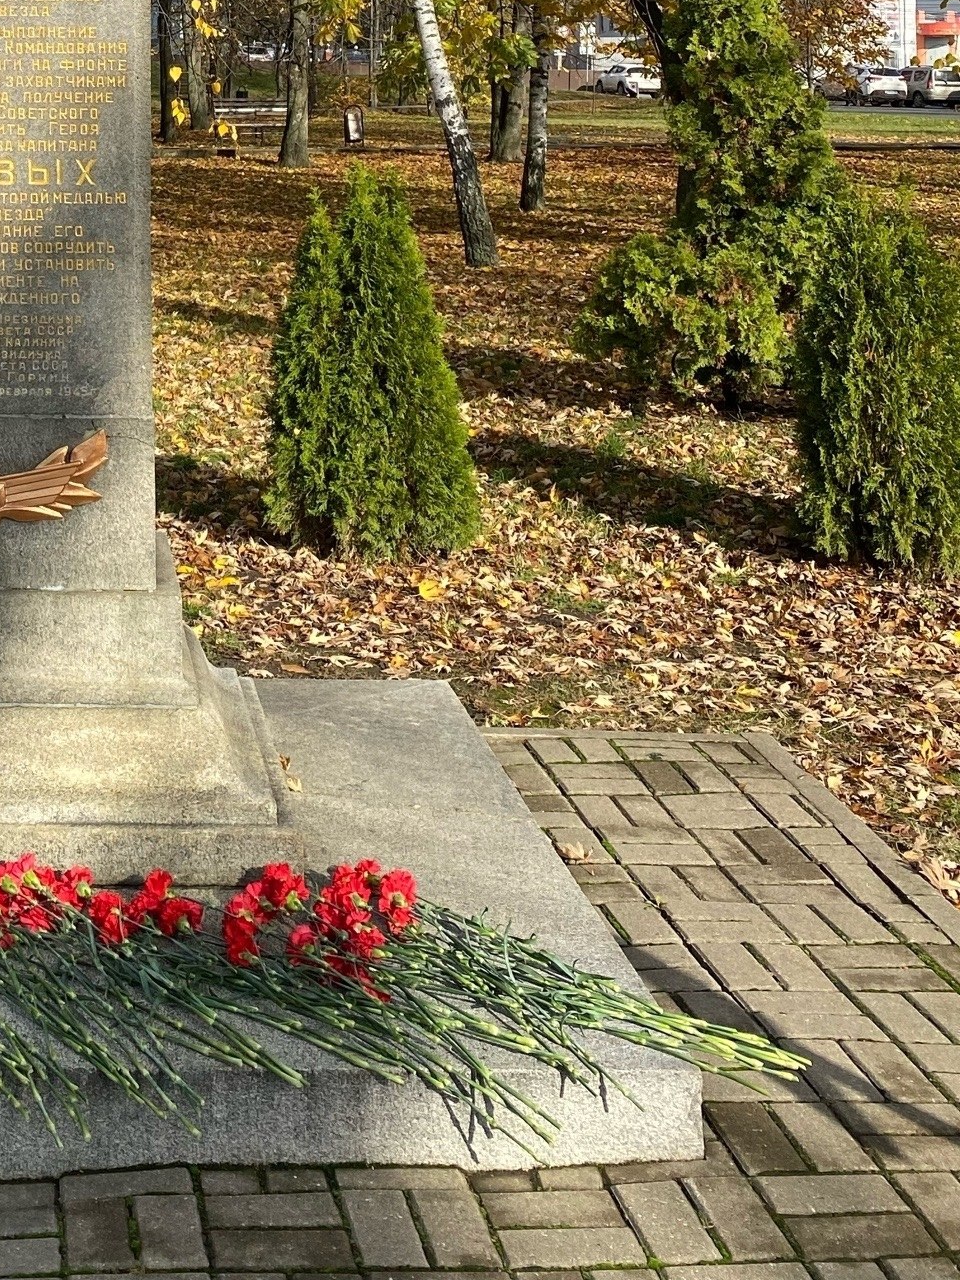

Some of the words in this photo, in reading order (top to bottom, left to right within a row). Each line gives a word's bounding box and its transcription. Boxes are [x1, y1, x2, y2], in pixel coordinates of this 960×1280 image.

[5, 41, 127, 55] КОМАНДОВАНИЯ
[32, 59, 51, 71] НА
[60, 58, 127, 71] ФРОНТЕ
[5, 75, 126, 87] ЗАХВАТЧИКАМИ
[24, 91, 113, 103] ПОЛУЧЕНИЕ
[49, 122, 99, 135] ГЕРОЯ
[17, 140, 97, 152] КАПИТАНА
[53, 192, 127, 204] МЕДАЛЬЮ
[54, 225, 84, 237] ЕГО
[24, 242, 115, 253] СООРУДИТЬ
[15, 259, 115, 271] УСТАНОВИТЬ
[61, 276, 80, 287] НА
[38, 326, 73, 335] СССР
[32, 360, 68, 370] СССР
